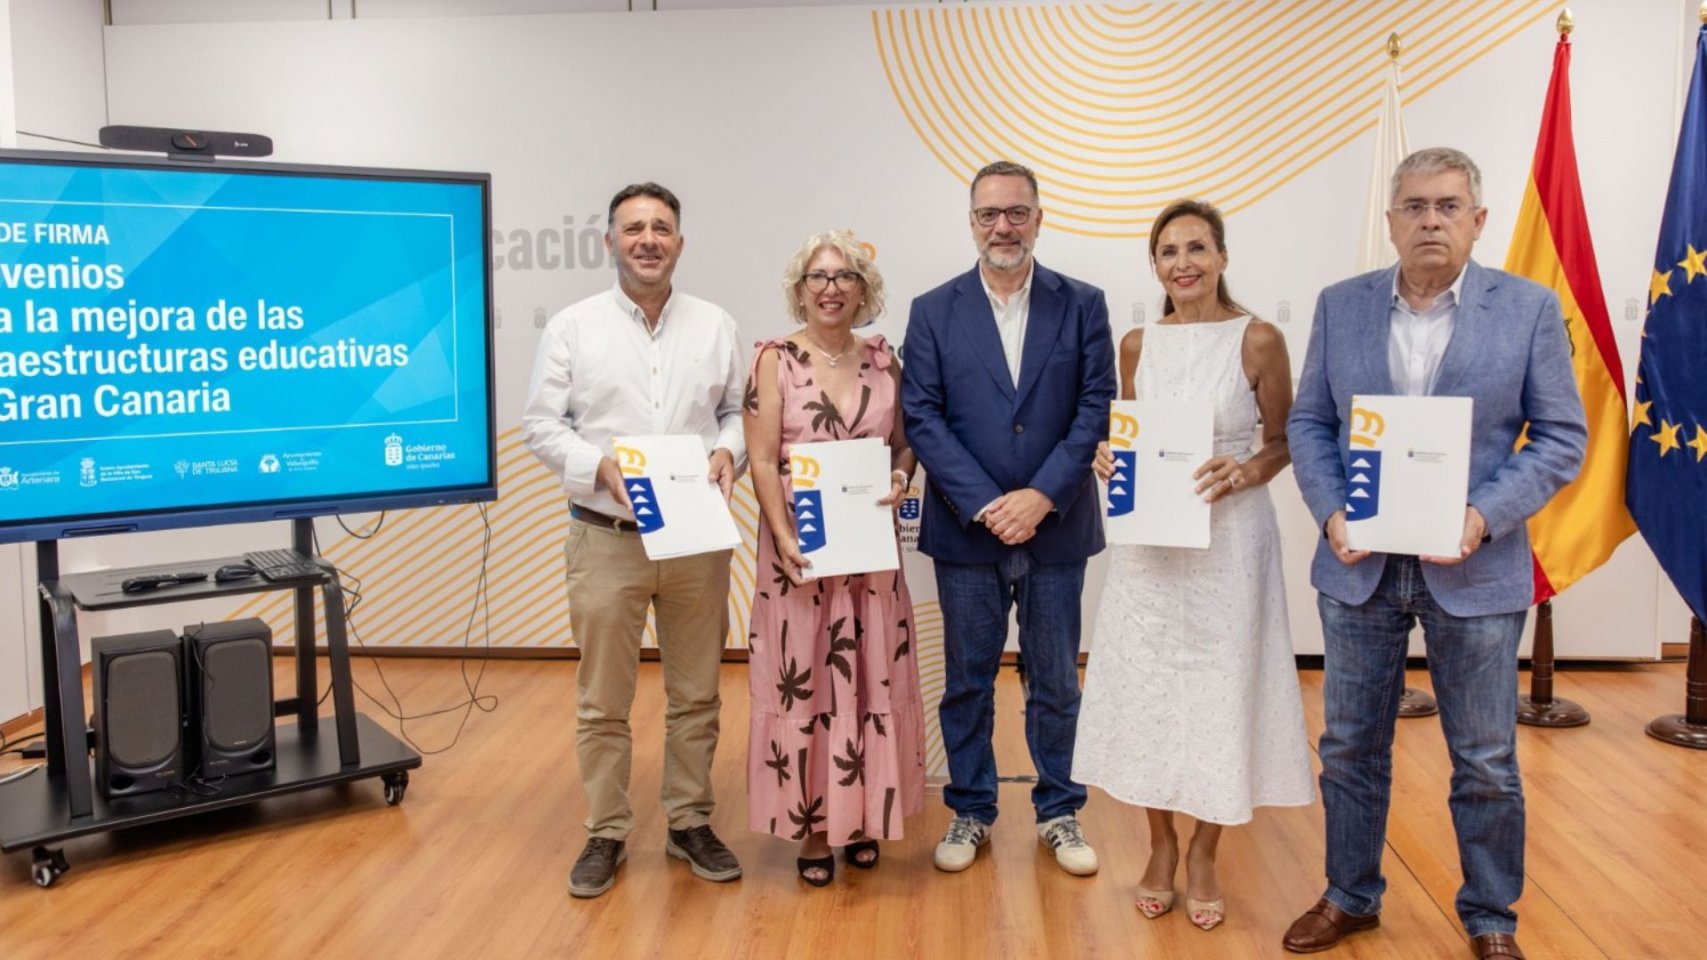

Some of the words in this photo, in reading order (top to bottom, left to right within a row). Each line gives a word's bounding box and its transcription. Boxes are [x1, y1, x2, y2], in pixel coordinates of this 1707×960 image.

[34, 223, 110, 245] FIRMA
[25, 299, 59, 333] la
[71, 299, 195, 340] mejora
[206, 299, 247, 331] de
[258, 299, 304, 330] las
[238, 339, 409, 371] educativas
[0, 387, 82, 421] Gran
[94, 381, 231, 417] Canaria
[405, 443, 447, 453] Gobierno
[417, 451, 456, 461] Canarias
